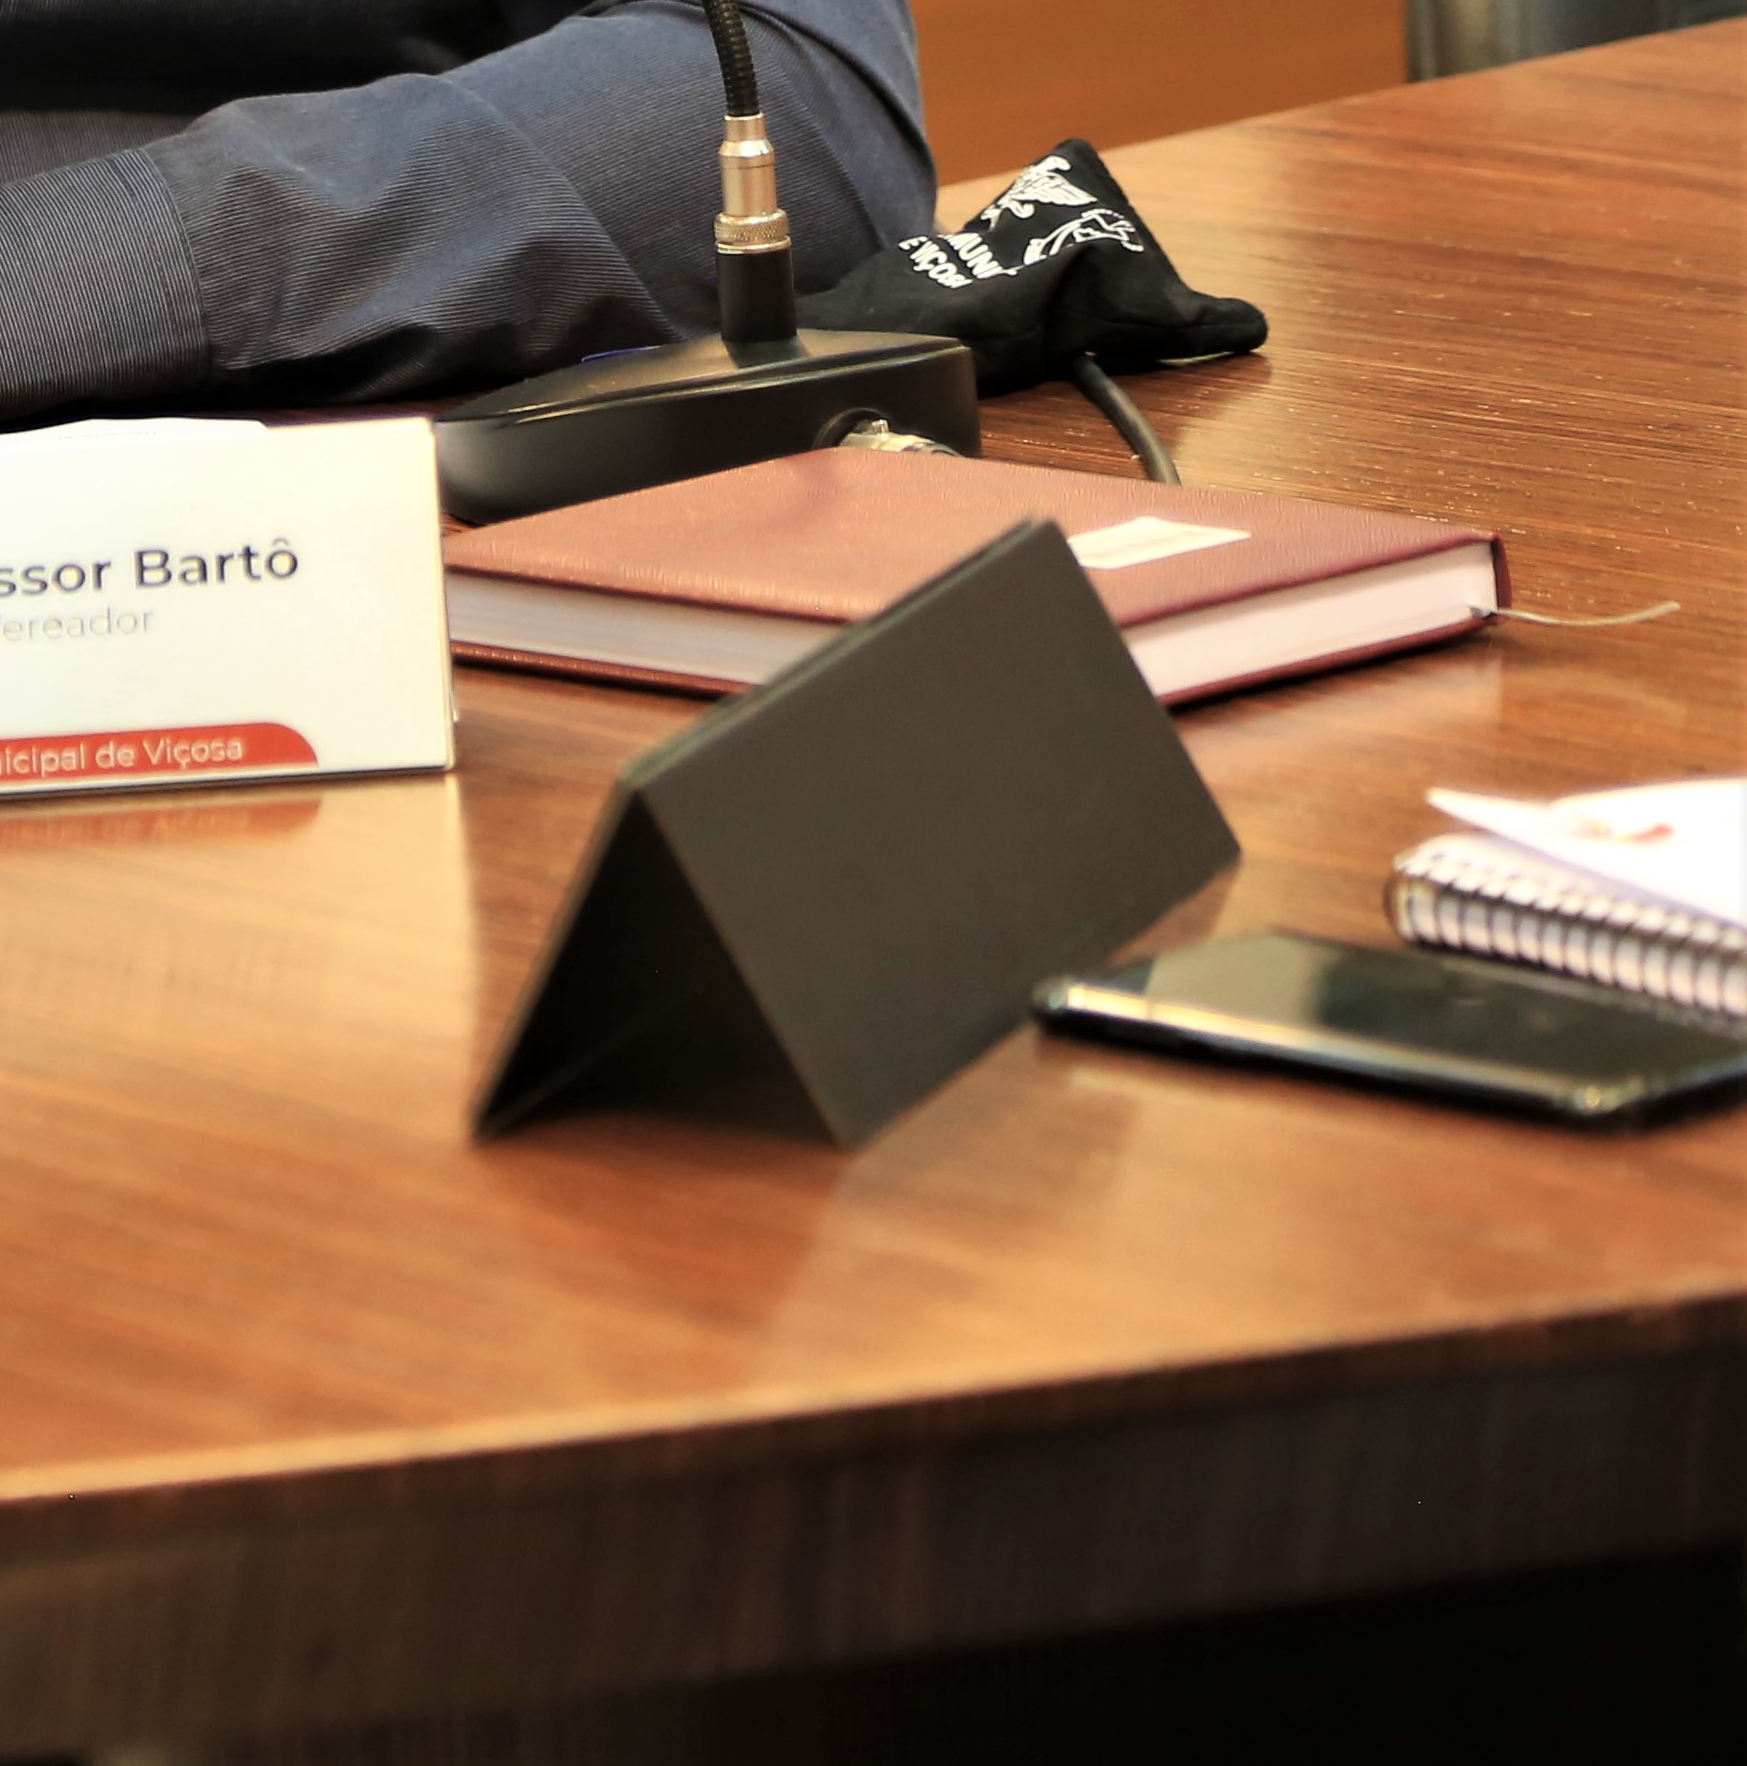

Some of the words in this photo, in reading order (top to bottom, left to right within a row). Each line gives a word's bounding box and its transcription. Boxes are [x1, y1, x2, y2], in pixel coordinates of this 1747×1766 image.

[134, 537, 298, 588] Bartô
[95, 740, 135, 769] de
[142, 736, 244, 771] Viçosa
